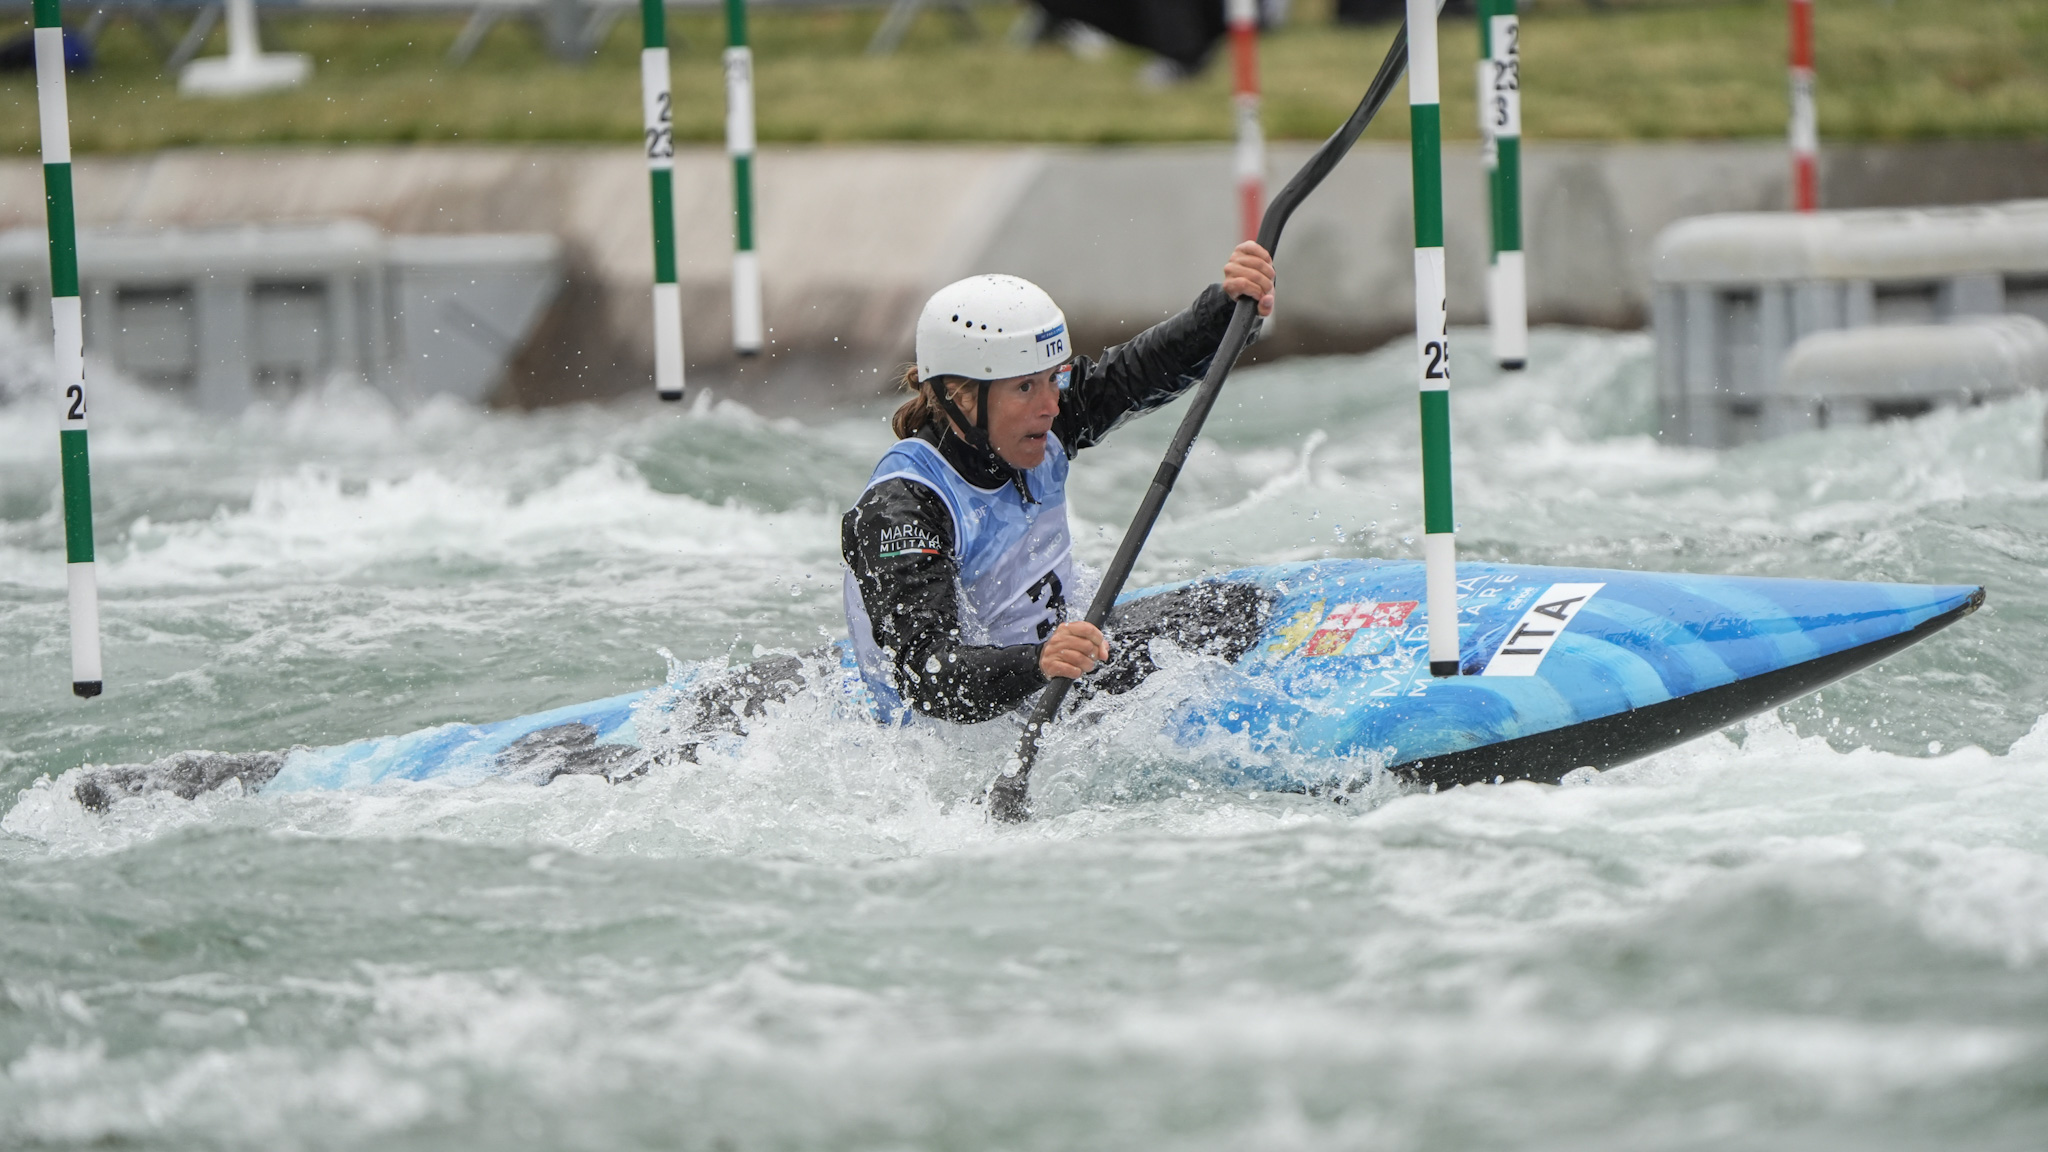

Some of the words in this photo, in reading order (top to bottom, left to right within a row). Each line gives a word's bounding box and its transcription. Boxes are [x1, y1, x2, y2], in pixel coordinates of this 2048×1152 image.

[1507, 24, 1519, 54] 2
[1494, 60, 1520, 91] 23
[657, 92, 672, 122] 2
[646, 128, 675, 158] 23
[1046, 338, 1064, 358] ITA
[66, 384, 87, 420] 2
[880, 523, 941, 544] MARINA
[1500, 595, 1588, 656] ITA
